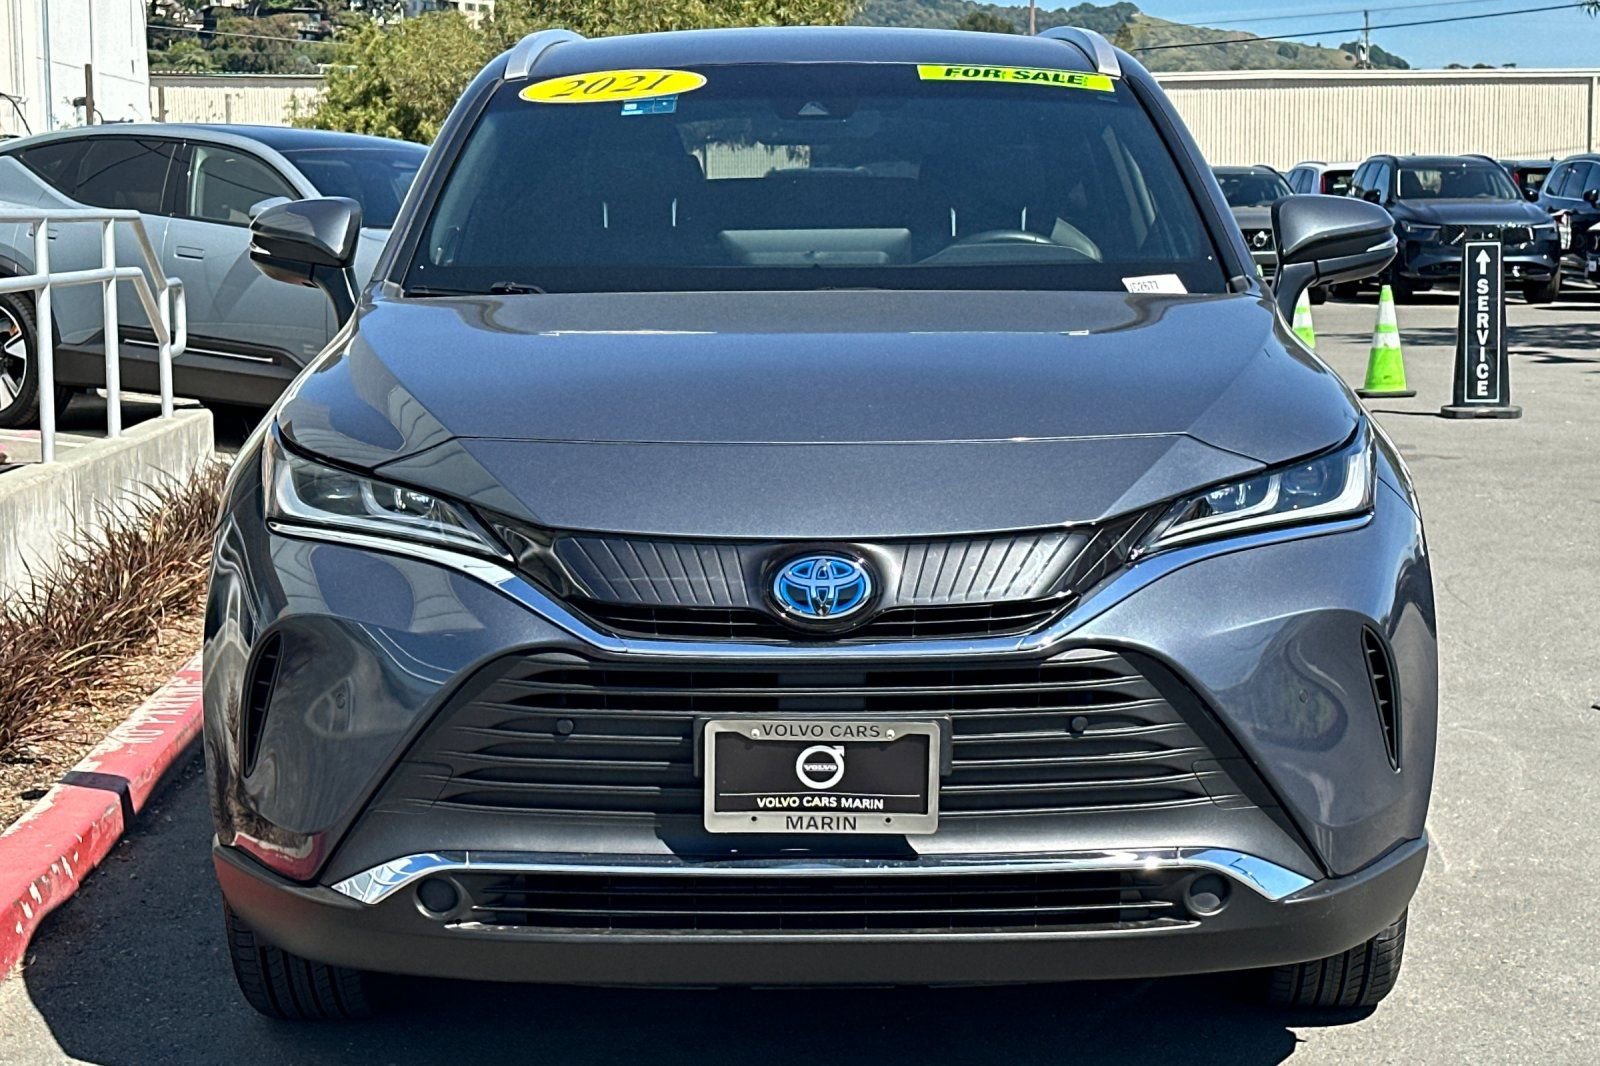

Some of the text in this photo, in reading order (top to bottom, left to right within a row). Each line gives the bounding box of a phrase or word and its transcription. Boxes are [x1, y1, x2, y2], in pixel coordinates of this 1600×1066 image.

[944, 67, 1088, 85] FOR SALE
[549, 75, 671, 98] 2021
[1476, 278, 1489, 396] SERVICE
[762, 724, 881, 738] VOLVO CARS
[803, 763, 837, 772] VOLVO
[757, 796, 884, 810] VOLVO CARS MARIN
[785, 816, 857, 831] MARIN
